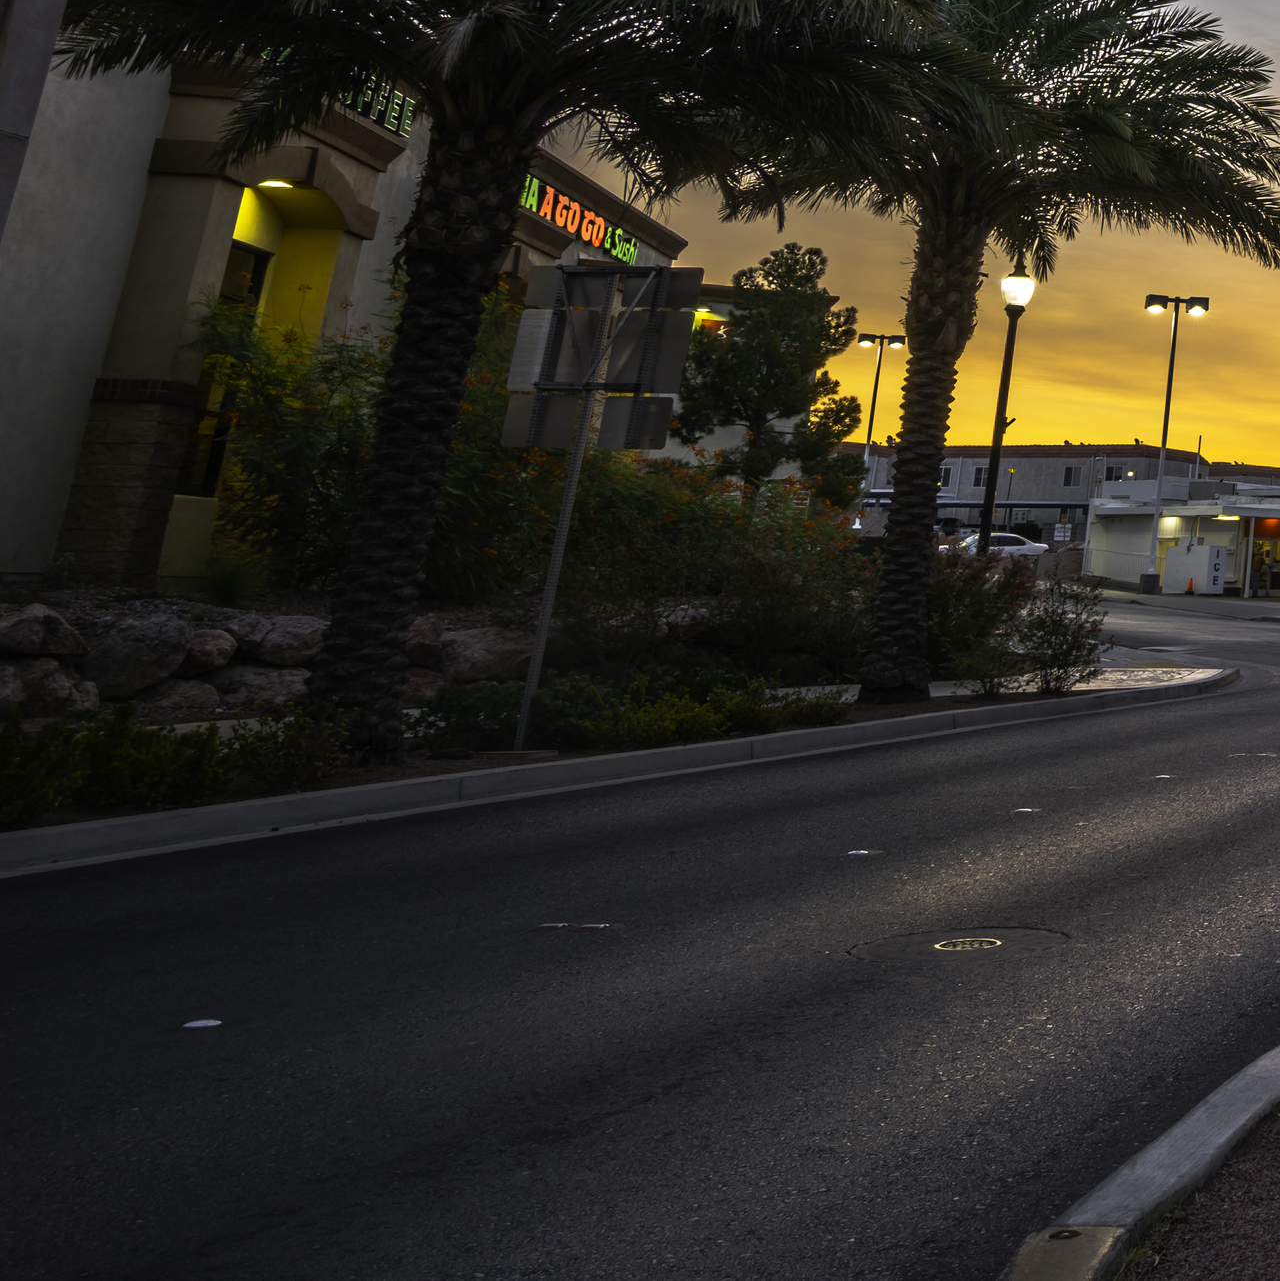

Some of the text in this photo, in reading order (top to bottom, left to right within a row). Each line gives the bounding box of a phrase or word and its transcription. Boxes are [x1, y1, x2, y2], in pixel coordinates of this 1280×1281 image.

[539, 185, 556, 221] A
[555, 194, 581, 234] GO
[581, 210, 606, 248] GO
[604, 226, 613, 250] &
[611, 227, 640, 265] Sushi
[1212, 549, 1221, 586] ICE
